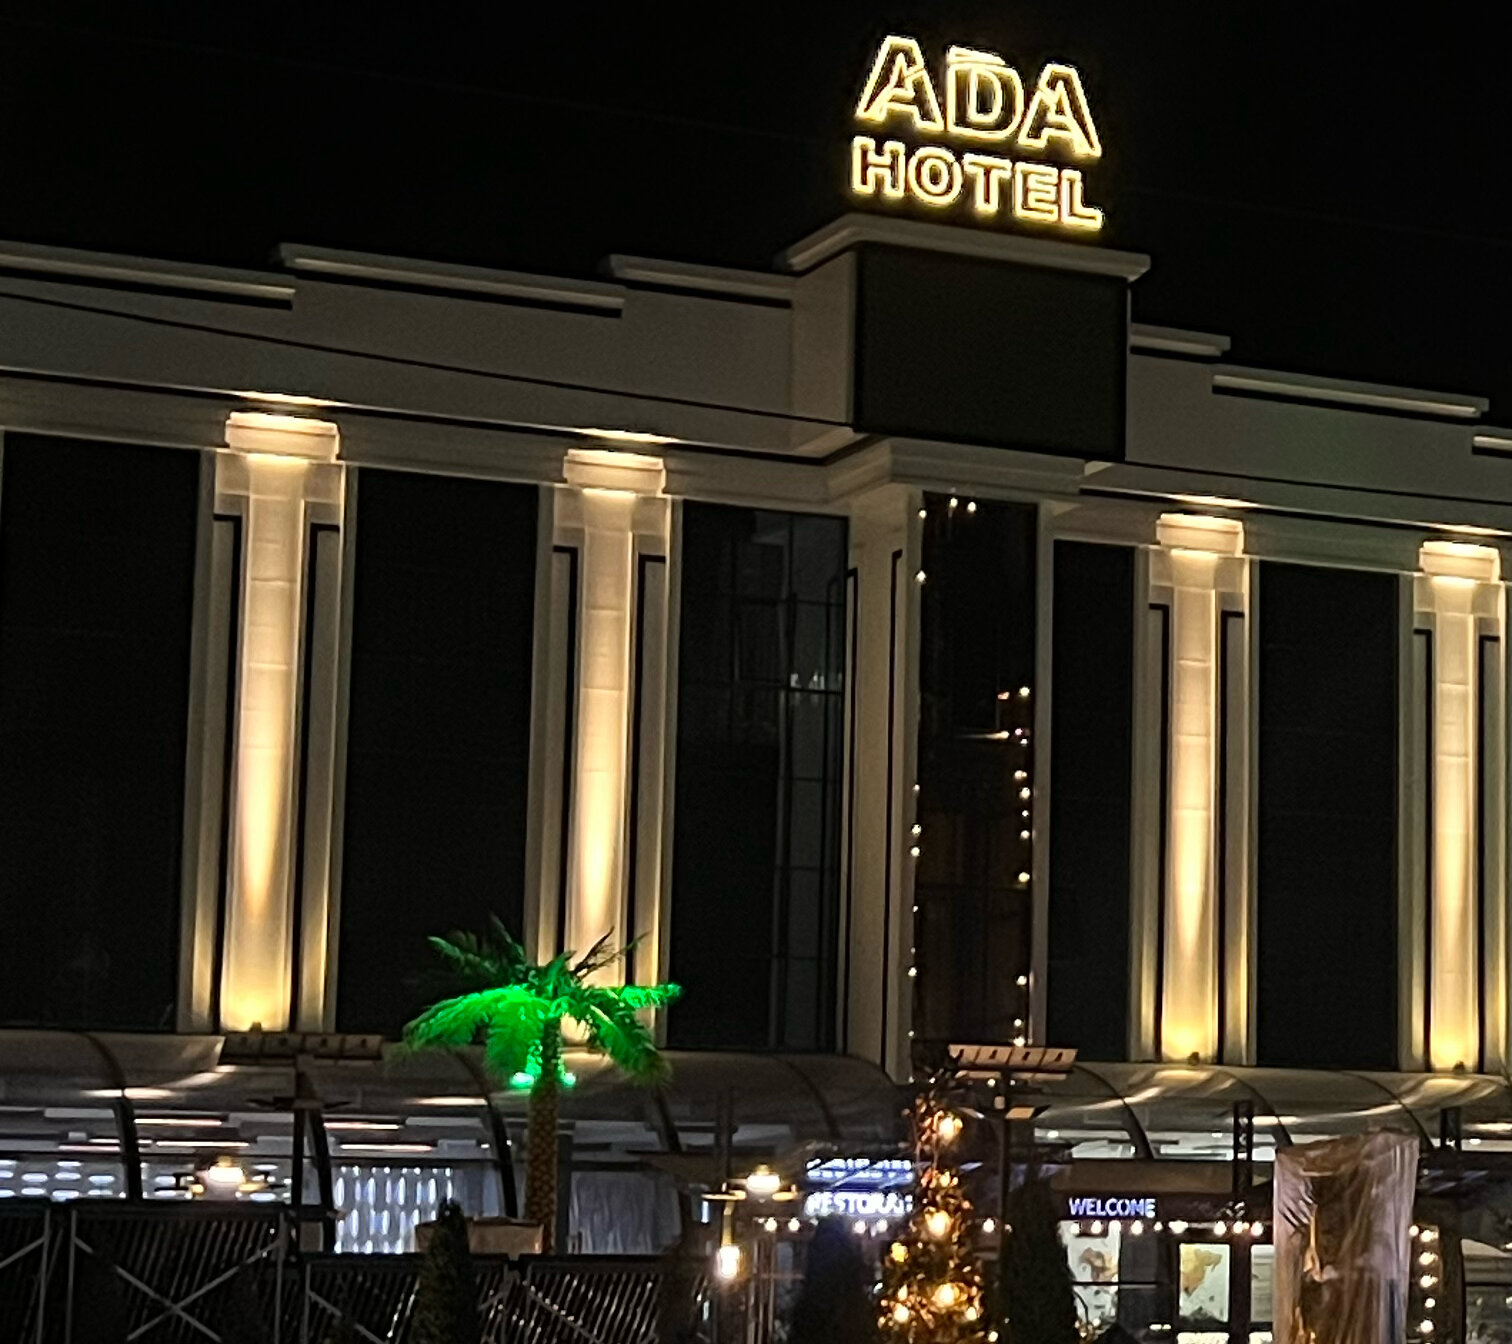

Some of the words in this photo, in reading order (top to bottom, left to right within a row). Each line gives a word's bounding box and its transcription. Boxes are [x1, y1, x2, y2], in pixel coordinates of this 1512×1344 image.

[855, 35, 1102, 157] ADA
[852, 136, 1103, 231] HOTEL
[1069, 1197, 1156, 1218] WELCOME
